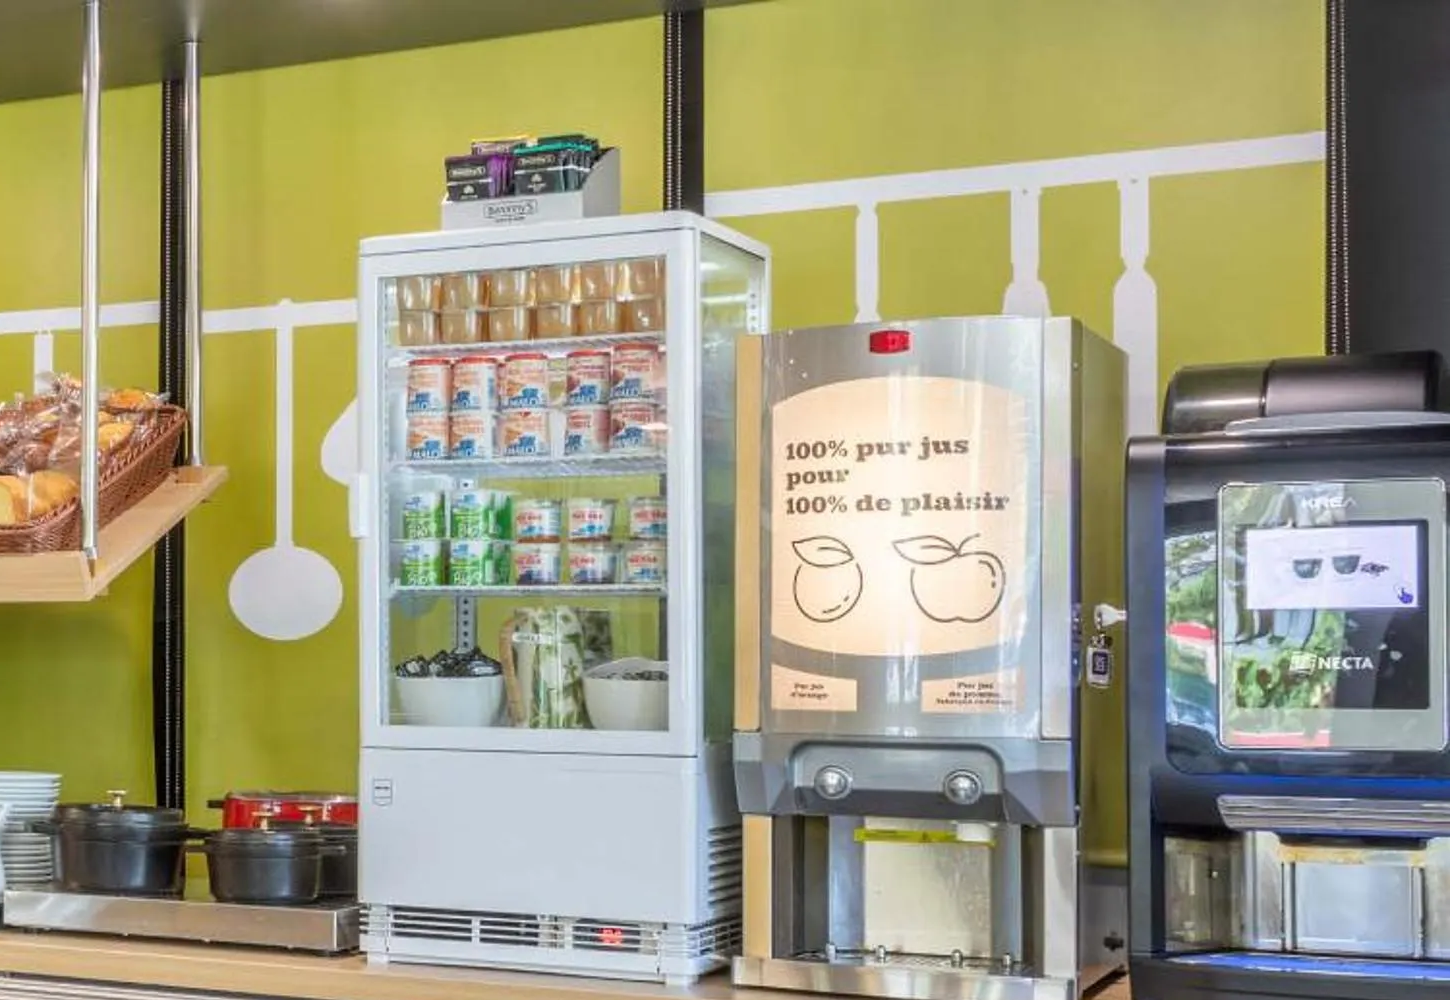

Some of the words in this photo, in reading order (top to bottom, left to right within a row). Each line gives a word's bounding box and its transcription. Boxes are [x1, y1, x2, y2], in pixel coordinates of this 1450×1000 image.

[785, 439, 848, 461] 100%
[855, 440, 912, 462] pur
[917, 436, 970, 460] jus
[785, 468, 850, 491] pour
[785, 494, 848, 515] 100%
[855, 494, 892, 512] de
[900, 491, 1010, 517] plaisir
[1318, 656, 1374, 671] NECTA
